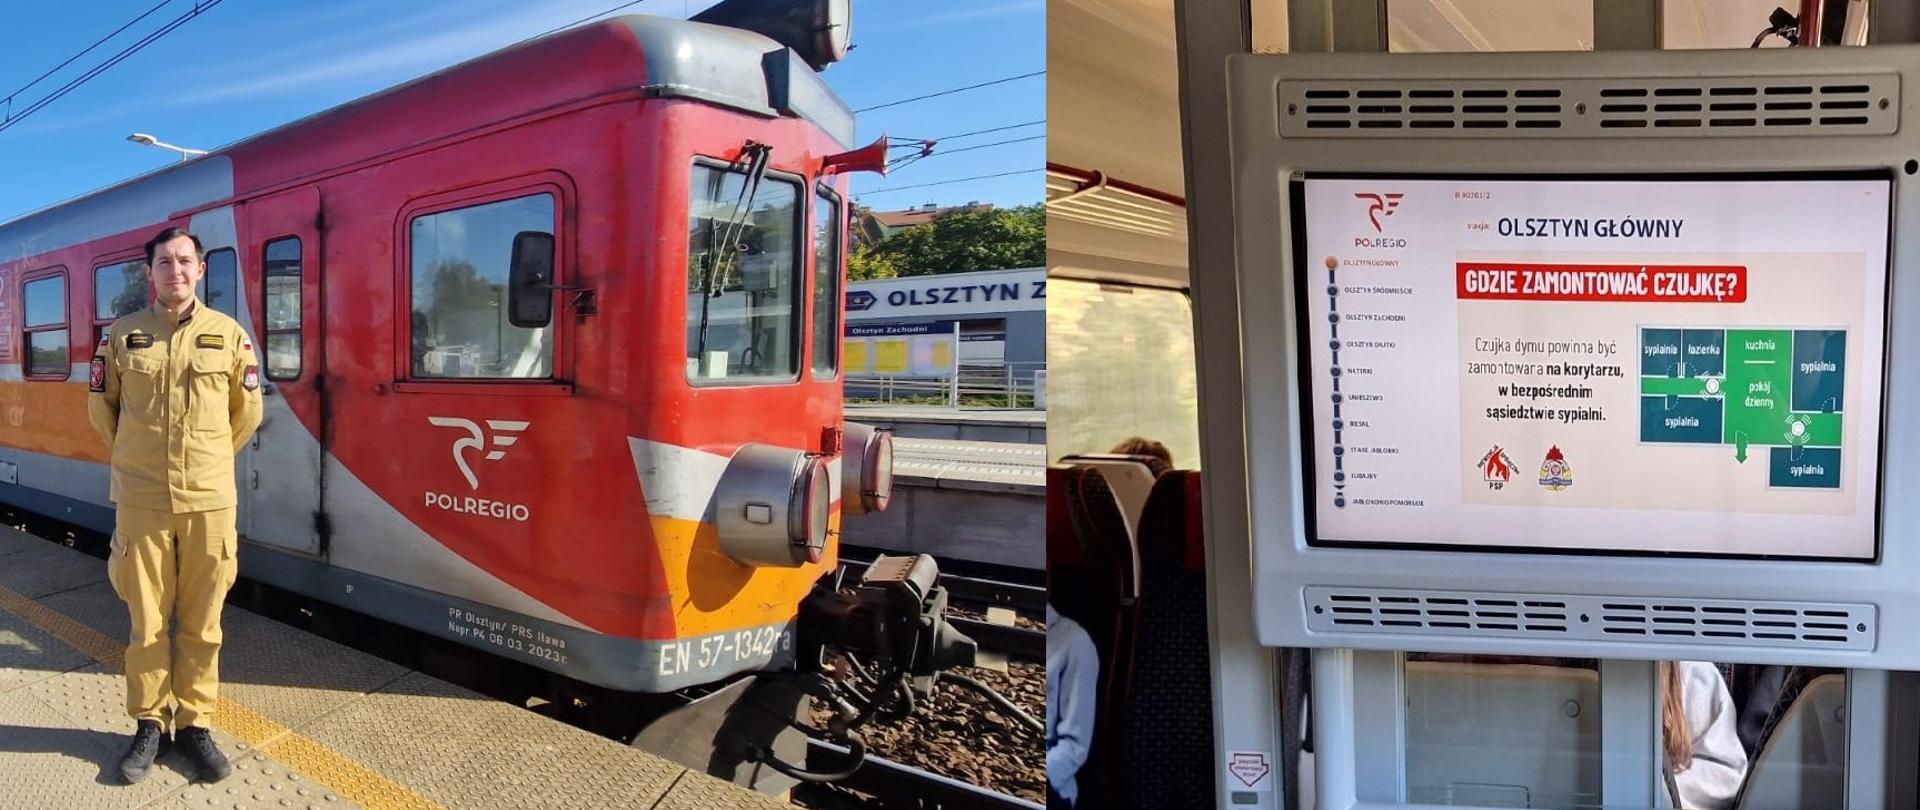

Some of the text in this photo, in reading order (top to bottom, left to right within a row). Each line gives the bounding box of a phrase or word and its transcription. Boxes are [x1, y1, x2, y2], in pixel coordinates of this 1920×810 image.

[1498, 217, 1588, 238] OLSZTYN
[1593, 214, 1684, 238] GŁÓWNY
[1355, 238, 1407, 248] POLREGIO
[1465, 267, 1737, 301] GDZIE ZAMONTOWAĆ CZUJKĘ?
[888, 283, 1019, 306] OLSZTYN
[852, 325, 927, 335] Olsztyn Zachodni
[1475, 337, 1617, 358] Czujka dymu powinna być
[1644, 343, 1677, 356] sypialnia
[1688, 343, 1720, 355] łazienka
[1745, 339, 1776, 350] kuchnia
[1468, 362, 1624, 379] zamontowana na korytarzu,
[1800, 361, 1836, 374] sypialnia
[1498, 382, 1593, 400] w bezpośrednim
[1749, 380, 1771, 395] pokój
[1744, 397, 1774, 410] dzienny
[1486, 404, 1606, 423] sąsiedztwie sypialni.
[1665, 416, 1700, 429] sypialnia
[1790, 464, 1825, 477] sypialnia
[1489, 482, 1504, 490] PSP
[425, 491, 529, 521] POLREGIO
[449, 607, 462, 619] PR
[511, 624, 534, 640] PRS
[658, 626, 791, 676] EN 57-1342ra
